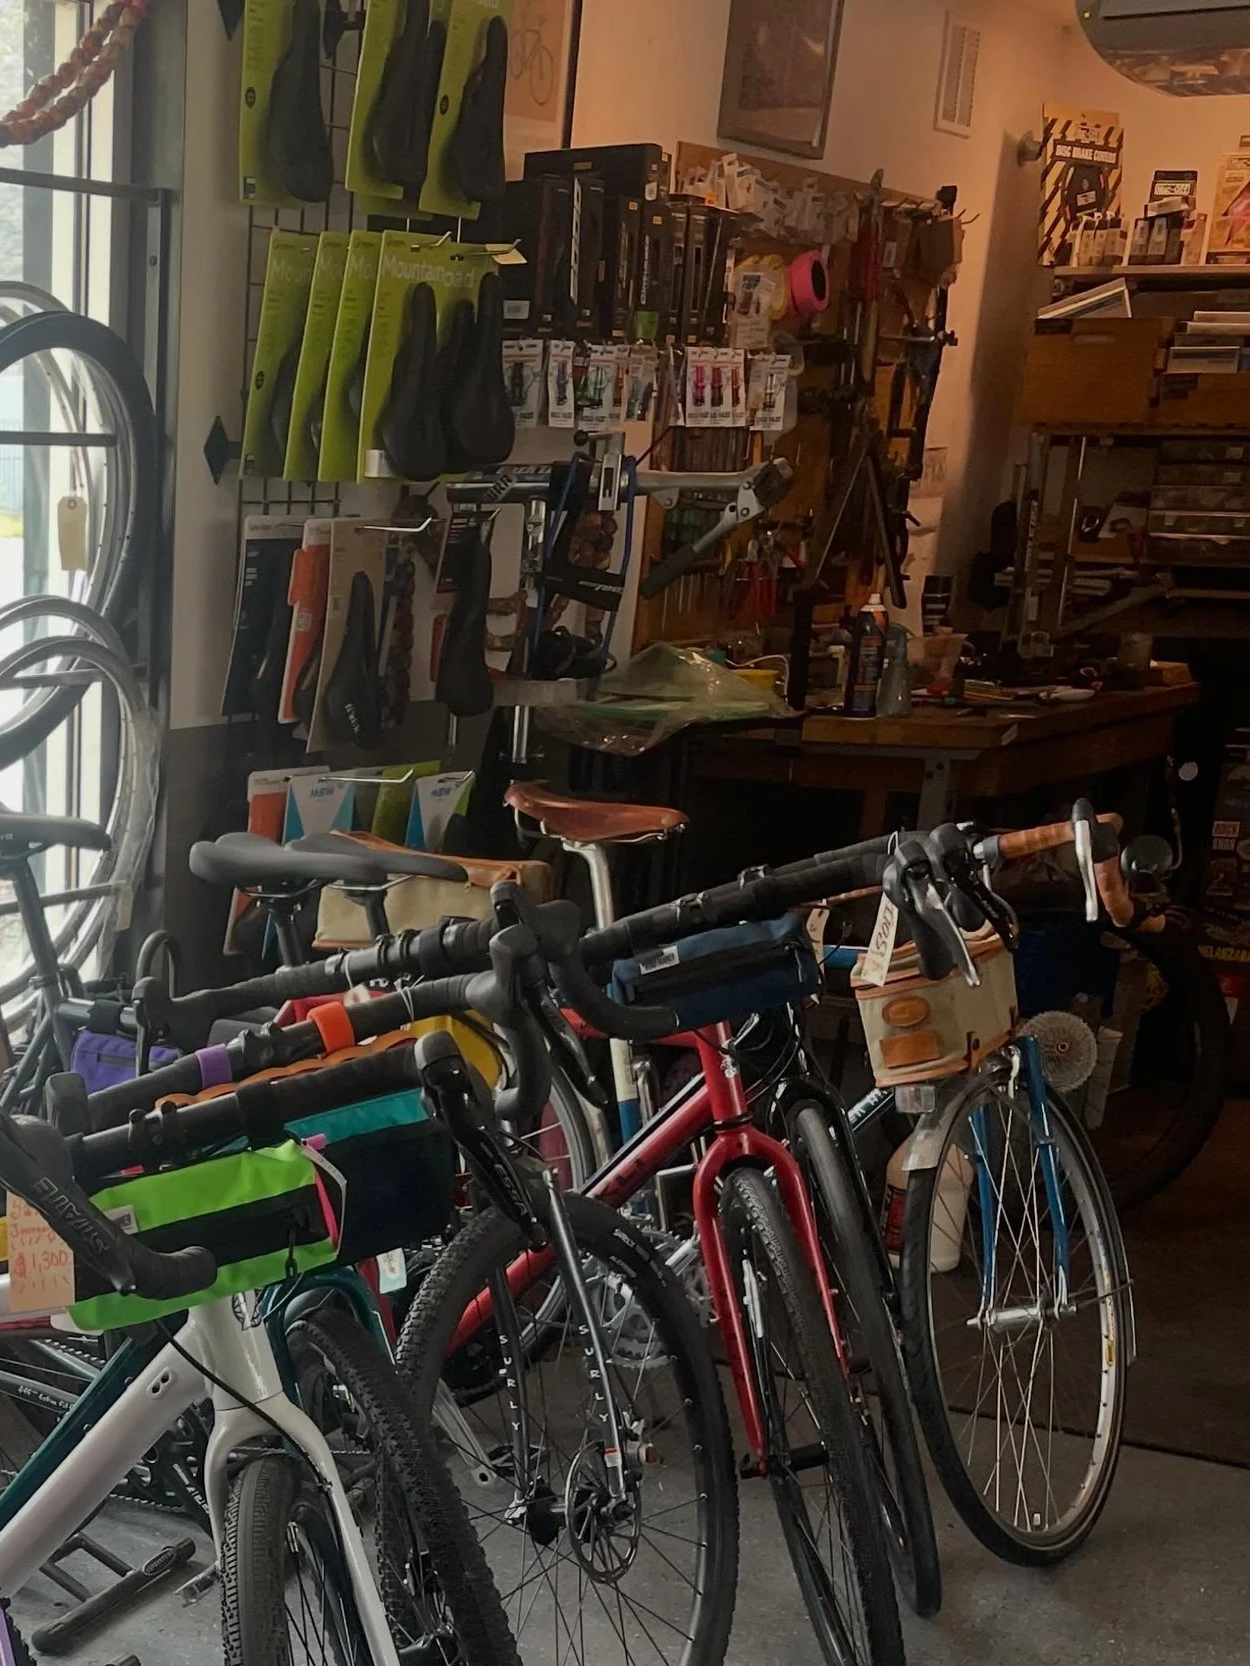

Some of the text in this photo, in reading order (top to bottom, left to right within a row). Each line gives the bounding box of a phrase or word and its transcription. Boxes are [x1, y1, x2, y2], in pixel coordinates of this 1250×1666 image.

[382, 252, 446, 282] Mountain
[445, 267, 475, 288] oad
[497, 1333, 521, 1432] SURLY
[577, 1322, 610, 1424] SURLY
